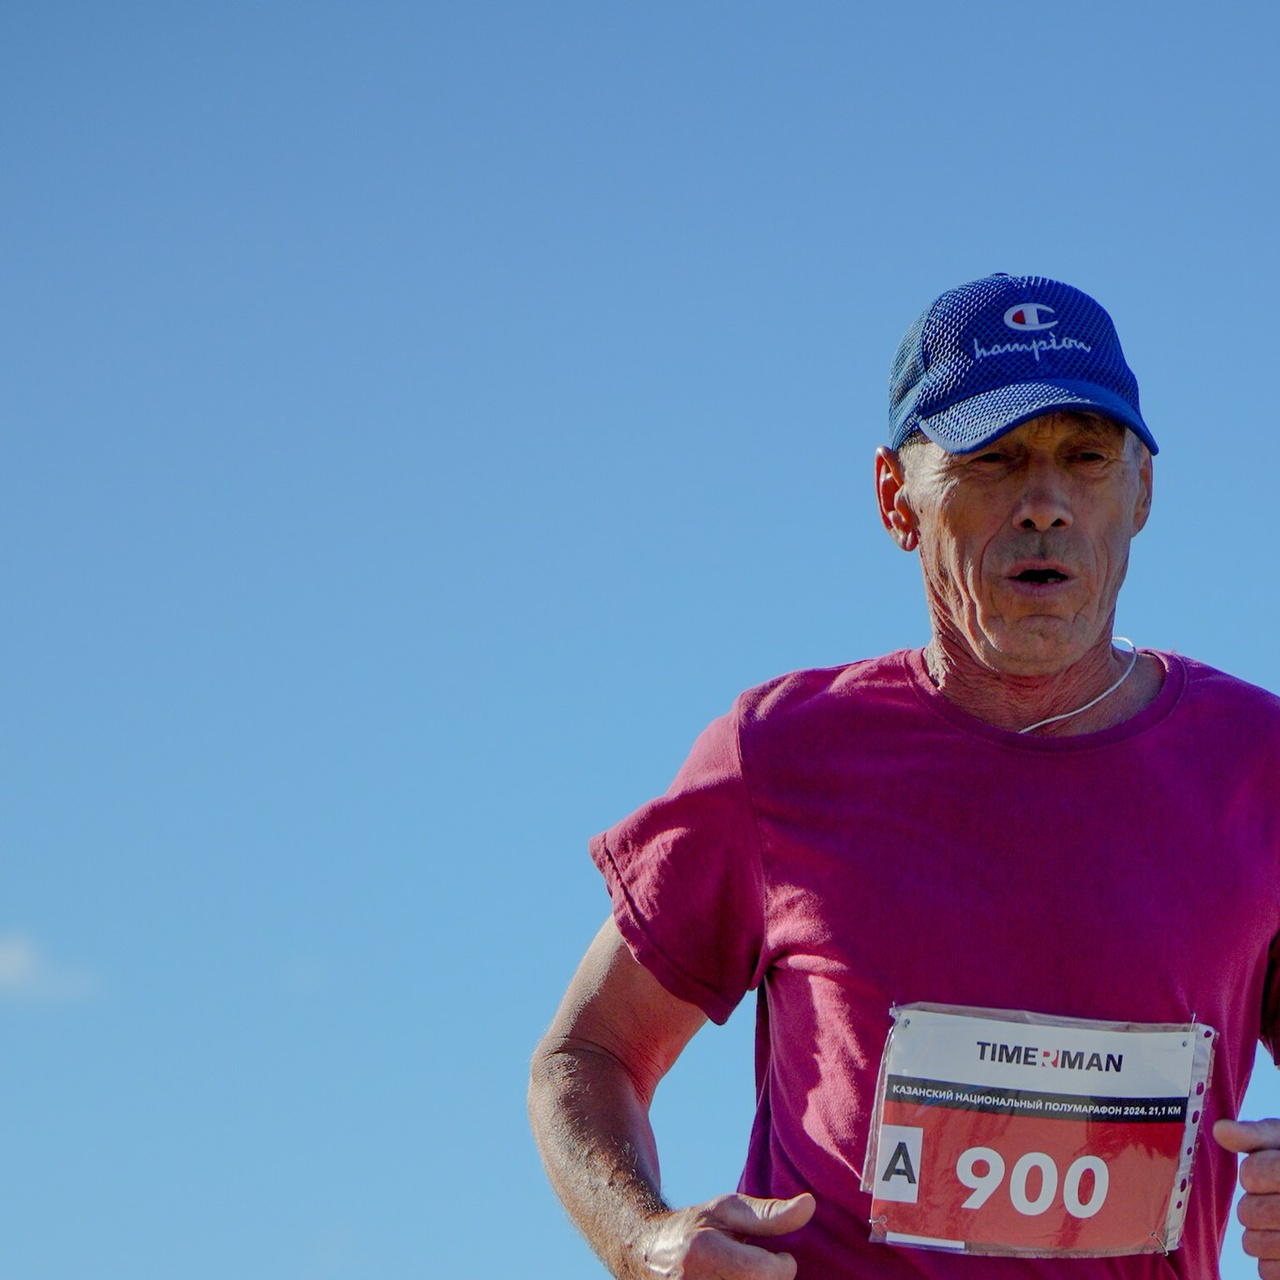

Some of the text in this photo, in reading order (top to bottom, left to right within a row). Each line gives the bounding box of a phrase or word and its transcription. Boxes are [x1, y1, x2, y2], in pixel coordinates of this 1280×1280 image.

[892, 1084, 1182, 1116] КАЗАНСКИЙ НАЦИОНАЛЬНЫЙ ПОЛУМАРАФОН 2024. 21,1 КМ
[955, 1146, 1110, 1219] 900
